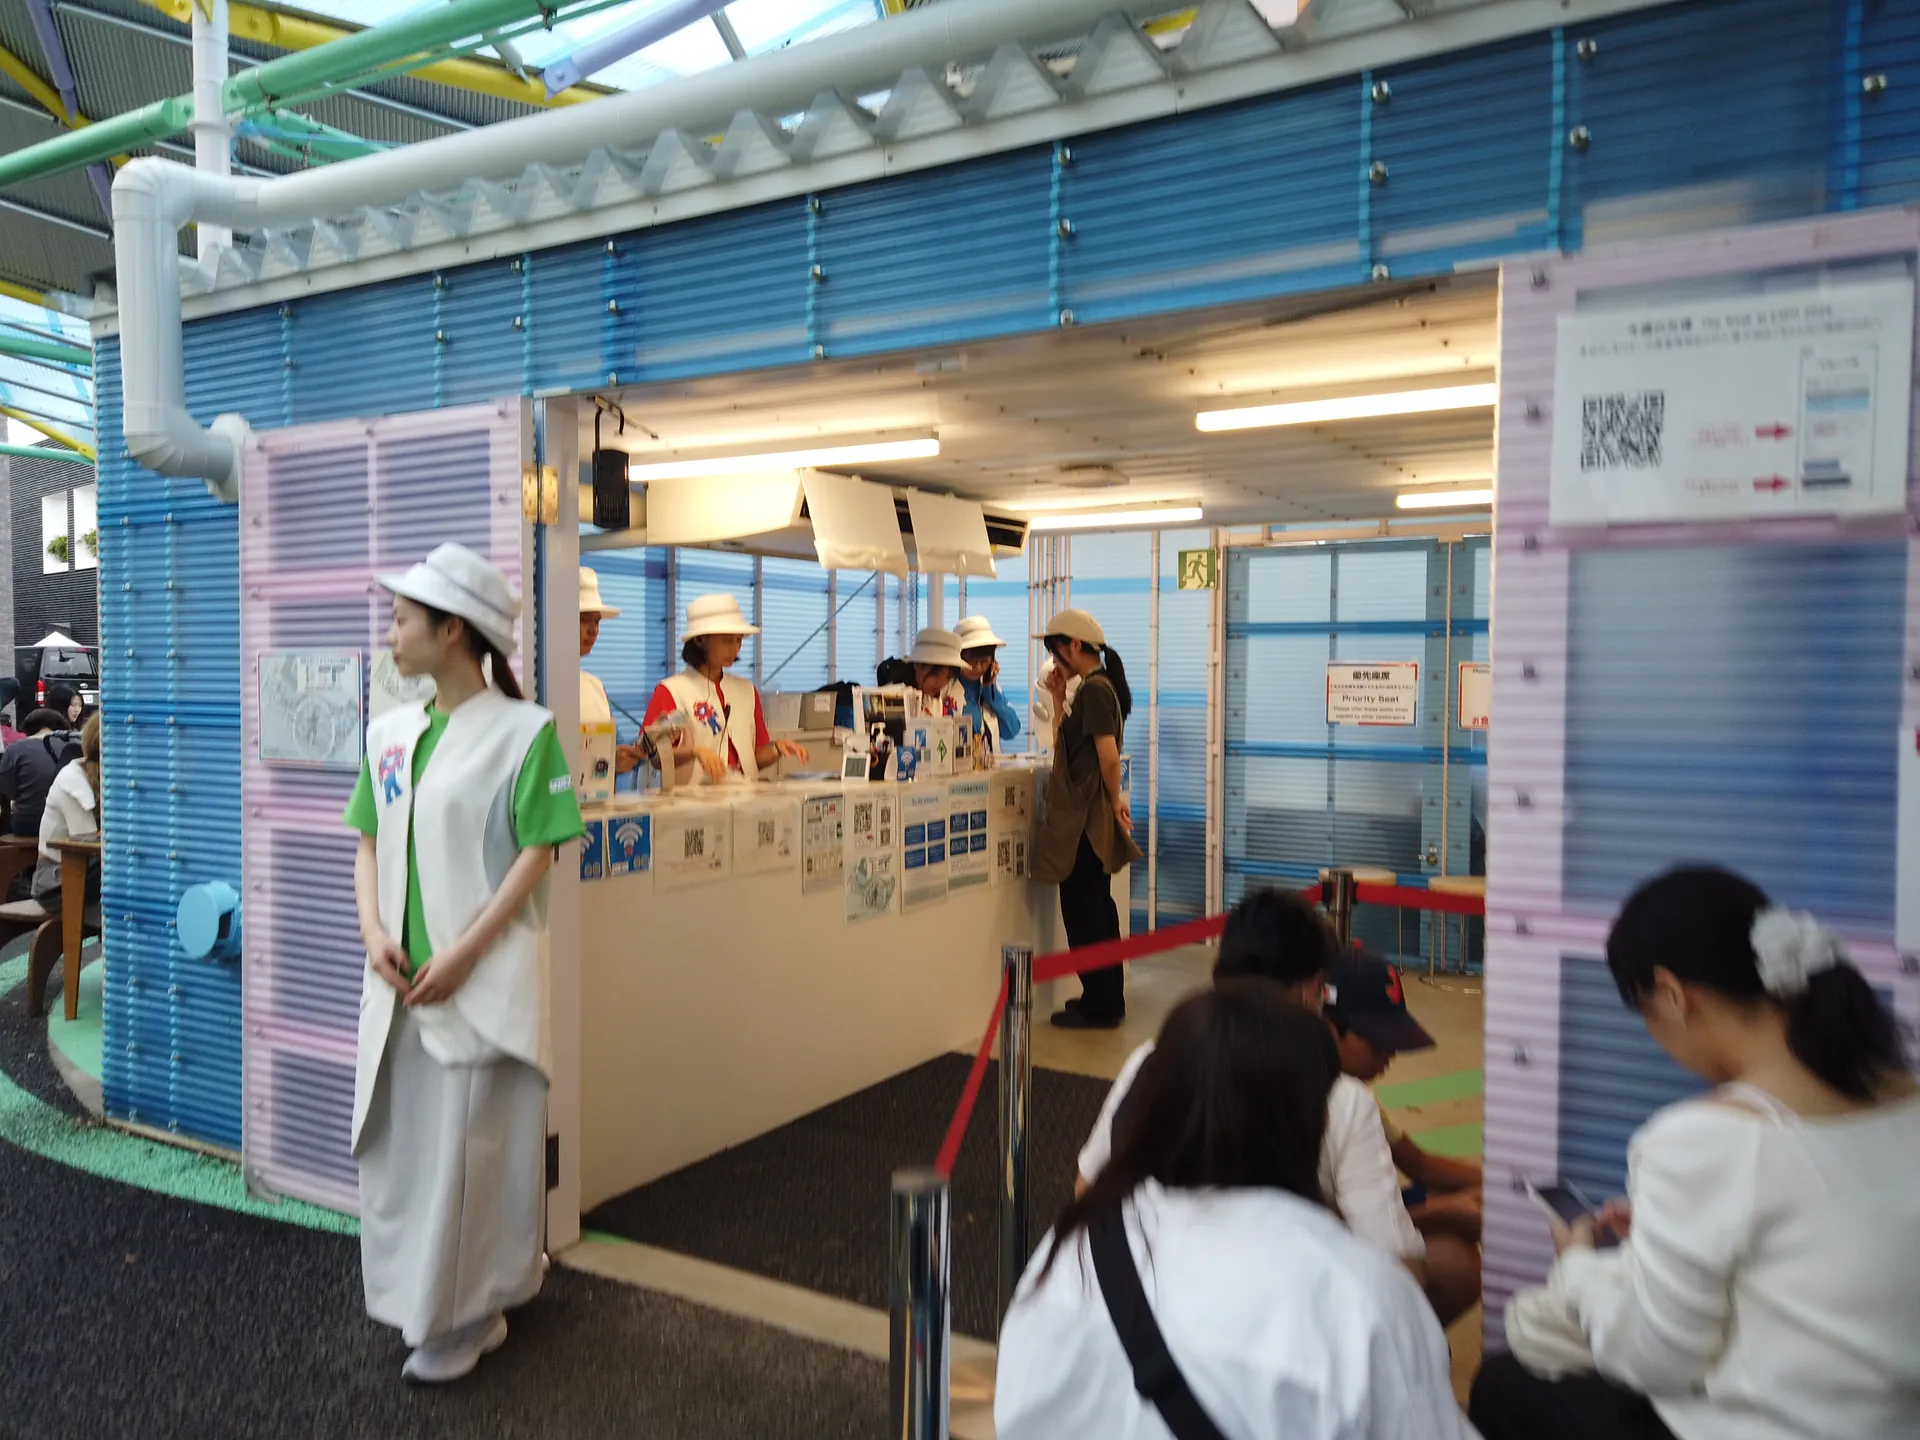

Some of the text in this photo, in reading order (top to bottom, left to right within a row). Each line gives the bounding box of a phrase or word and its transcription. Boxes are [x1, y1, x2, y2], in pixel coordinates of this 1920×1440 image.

[1352, 670, 1391, 680] 優先座席
[1342, 694, 1399, 704] Priority Seat
